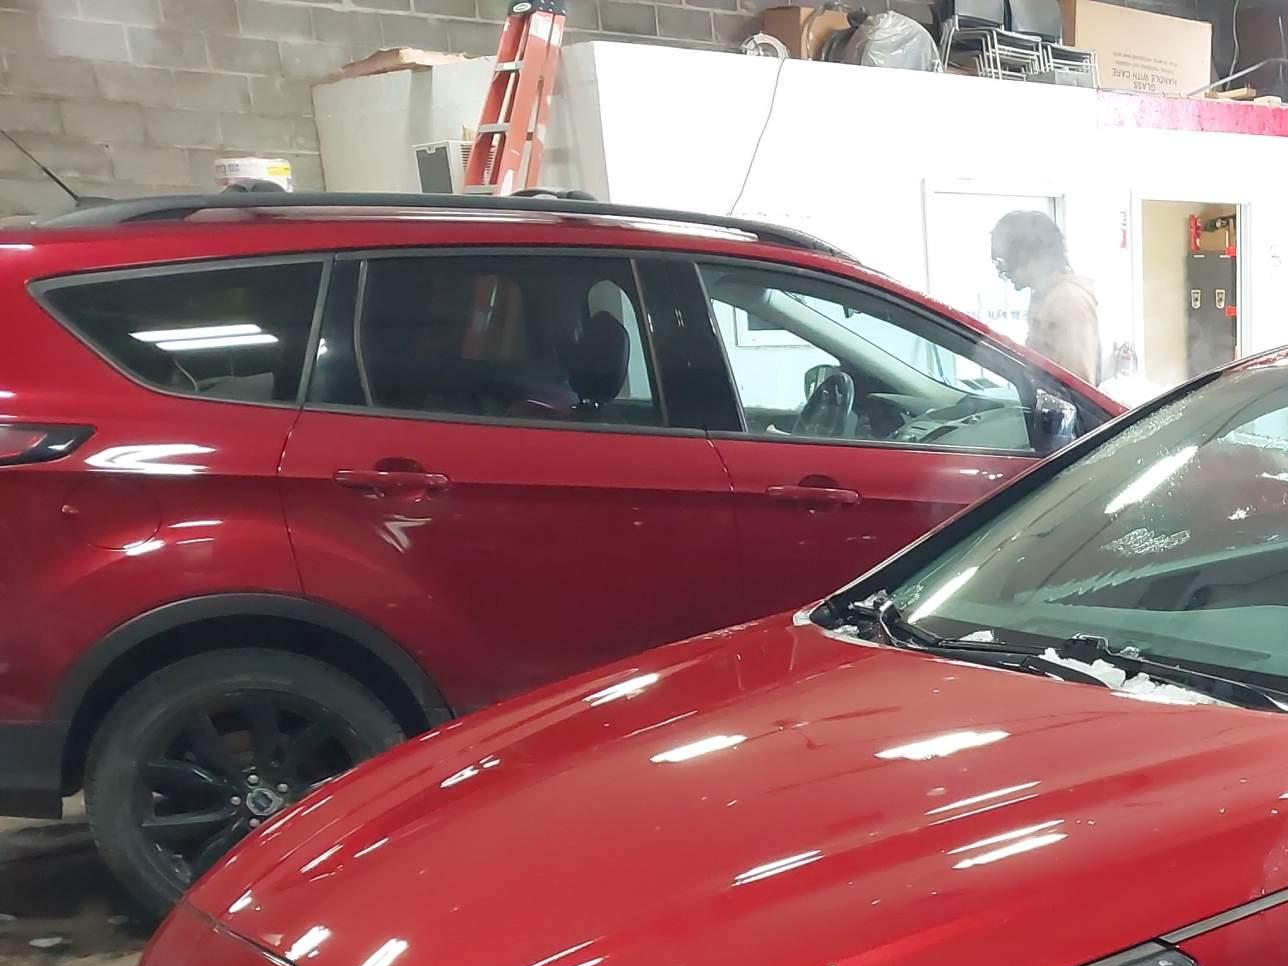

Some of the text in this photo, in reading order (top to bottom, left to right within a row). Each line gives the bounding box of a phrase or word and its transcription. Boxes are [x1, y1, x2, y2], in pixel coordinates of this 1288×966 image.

[1112, 68, 1177, 86] HANDLE WITH CARE
[1133, 81, 1156, 91] GLASS
